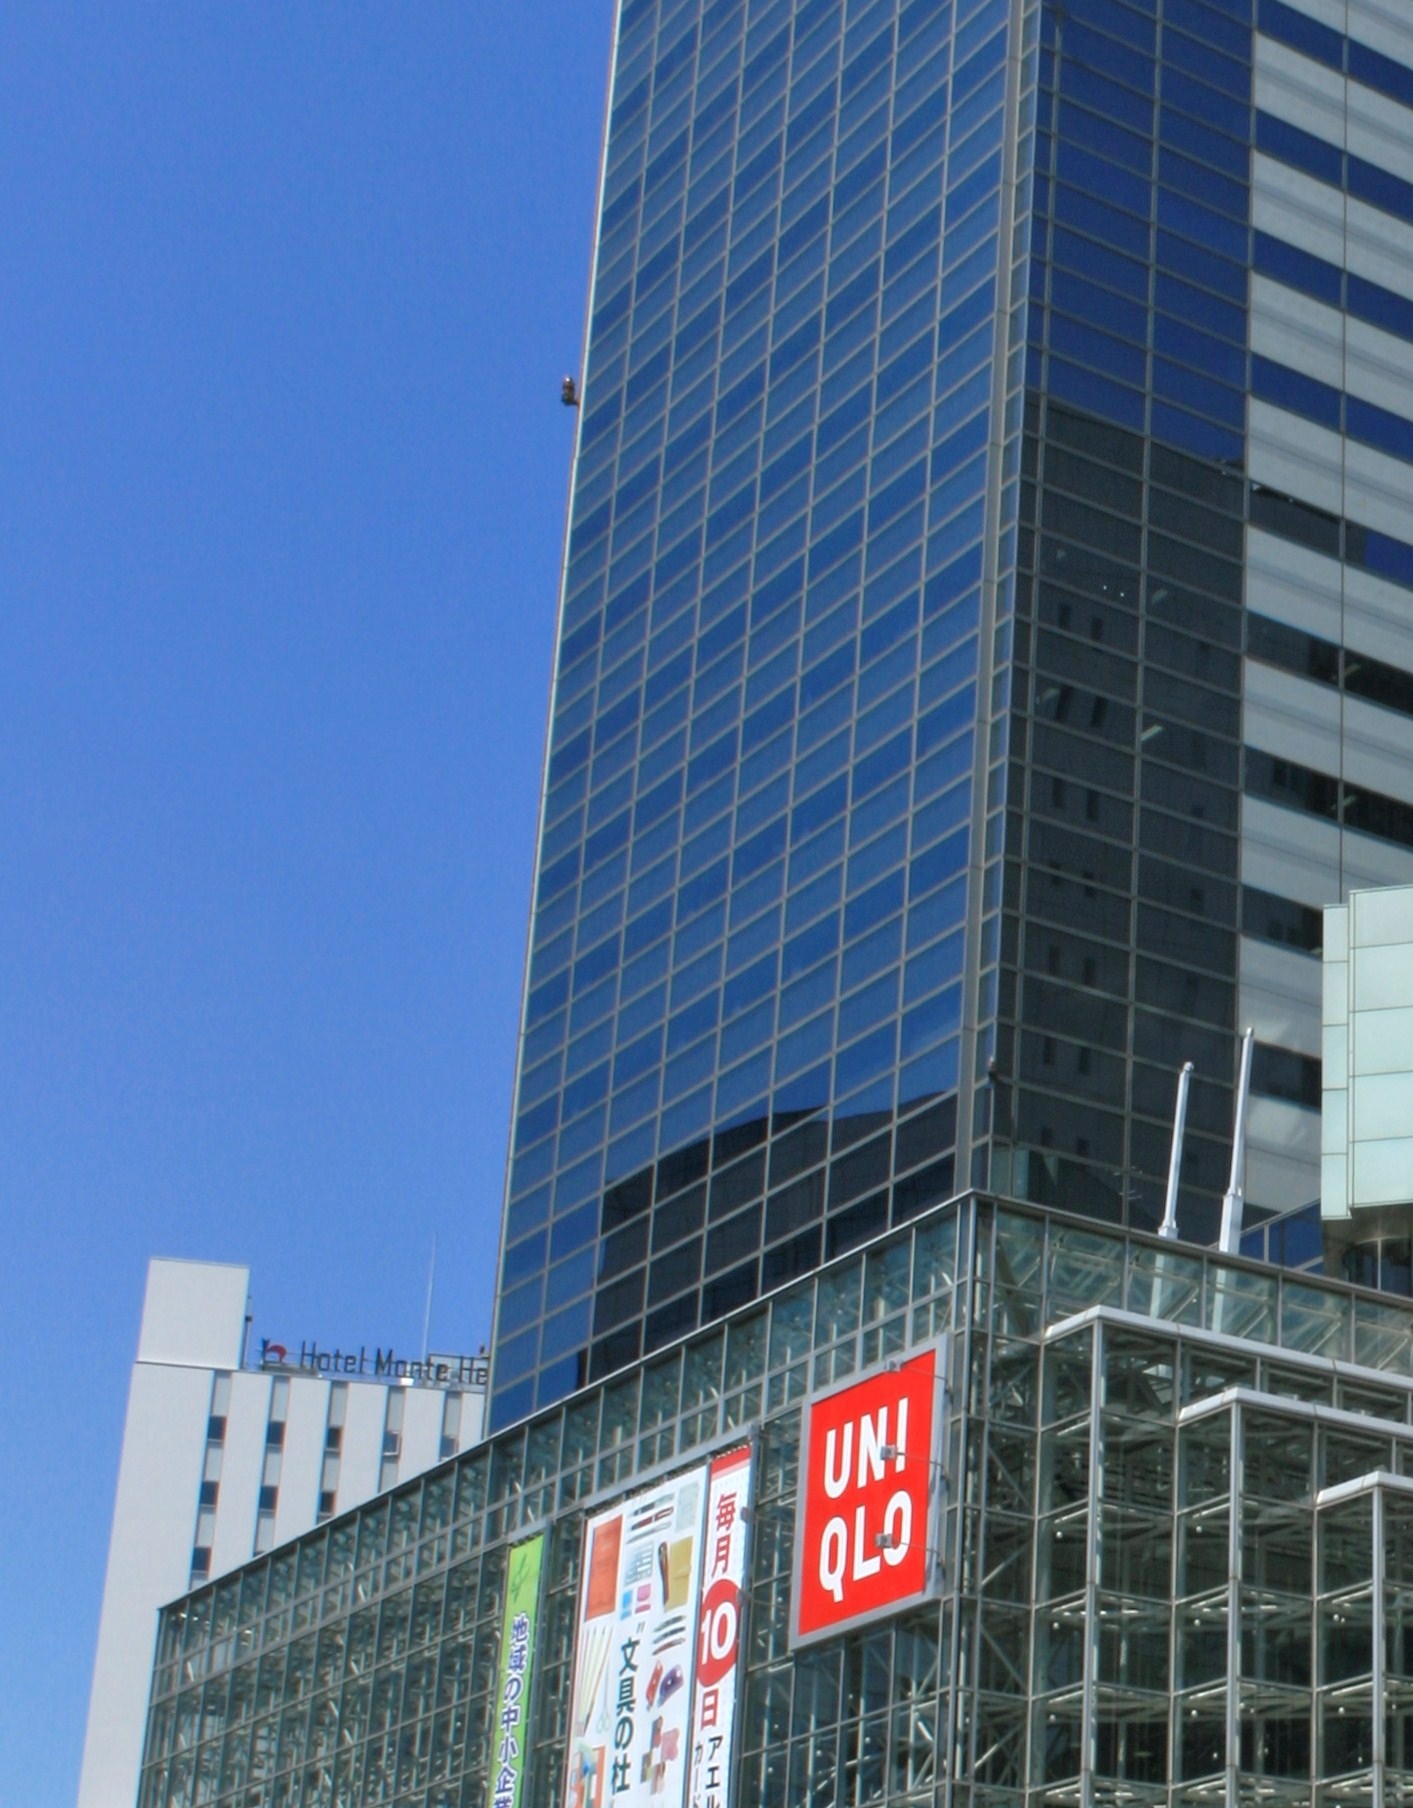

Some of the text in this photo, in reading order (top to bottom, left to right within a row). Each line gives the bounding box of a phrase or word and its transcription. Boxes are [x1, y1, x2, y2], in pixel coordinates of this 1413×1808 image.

[301, 1341, 365, 1375] Hotel
[375, 1347, 450, 1381] Monte
[824, 1397, 909, 1499] UNI
[819, 1490, 913, 1603] QLO
